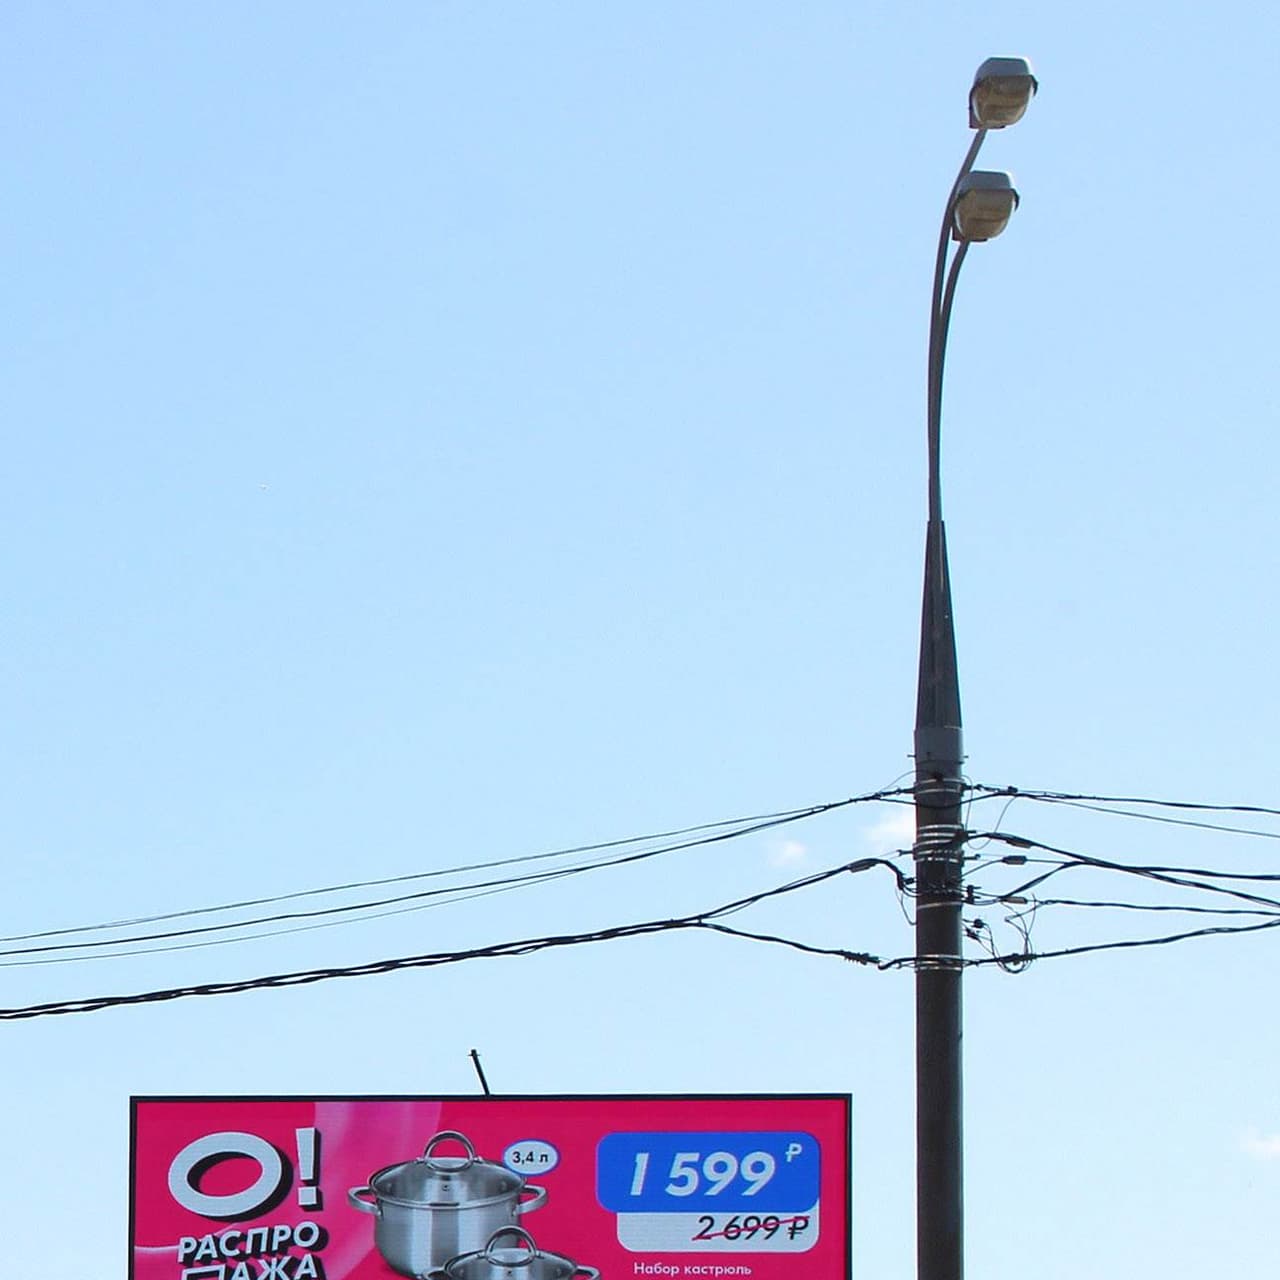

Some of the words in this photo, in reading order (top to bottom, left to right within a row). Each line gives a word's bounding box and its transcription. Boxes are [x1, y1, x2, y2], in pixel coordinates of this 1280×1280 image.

[168, 1127, 320, 1218] О!
[512, 1151, 535, 1165] 3,4
[630, 1152, 649, 1196] 1
[665, 1150, 776, 1197] 599
[177, 1221, 321, 1264] РАСПРО
[694, 1215, 716, 1241] 2
[723, 1215, 781, 1241] 699
[633, 1261, 680, 1277] Набор
[684, 1264, 753, 1277] кастрюль
